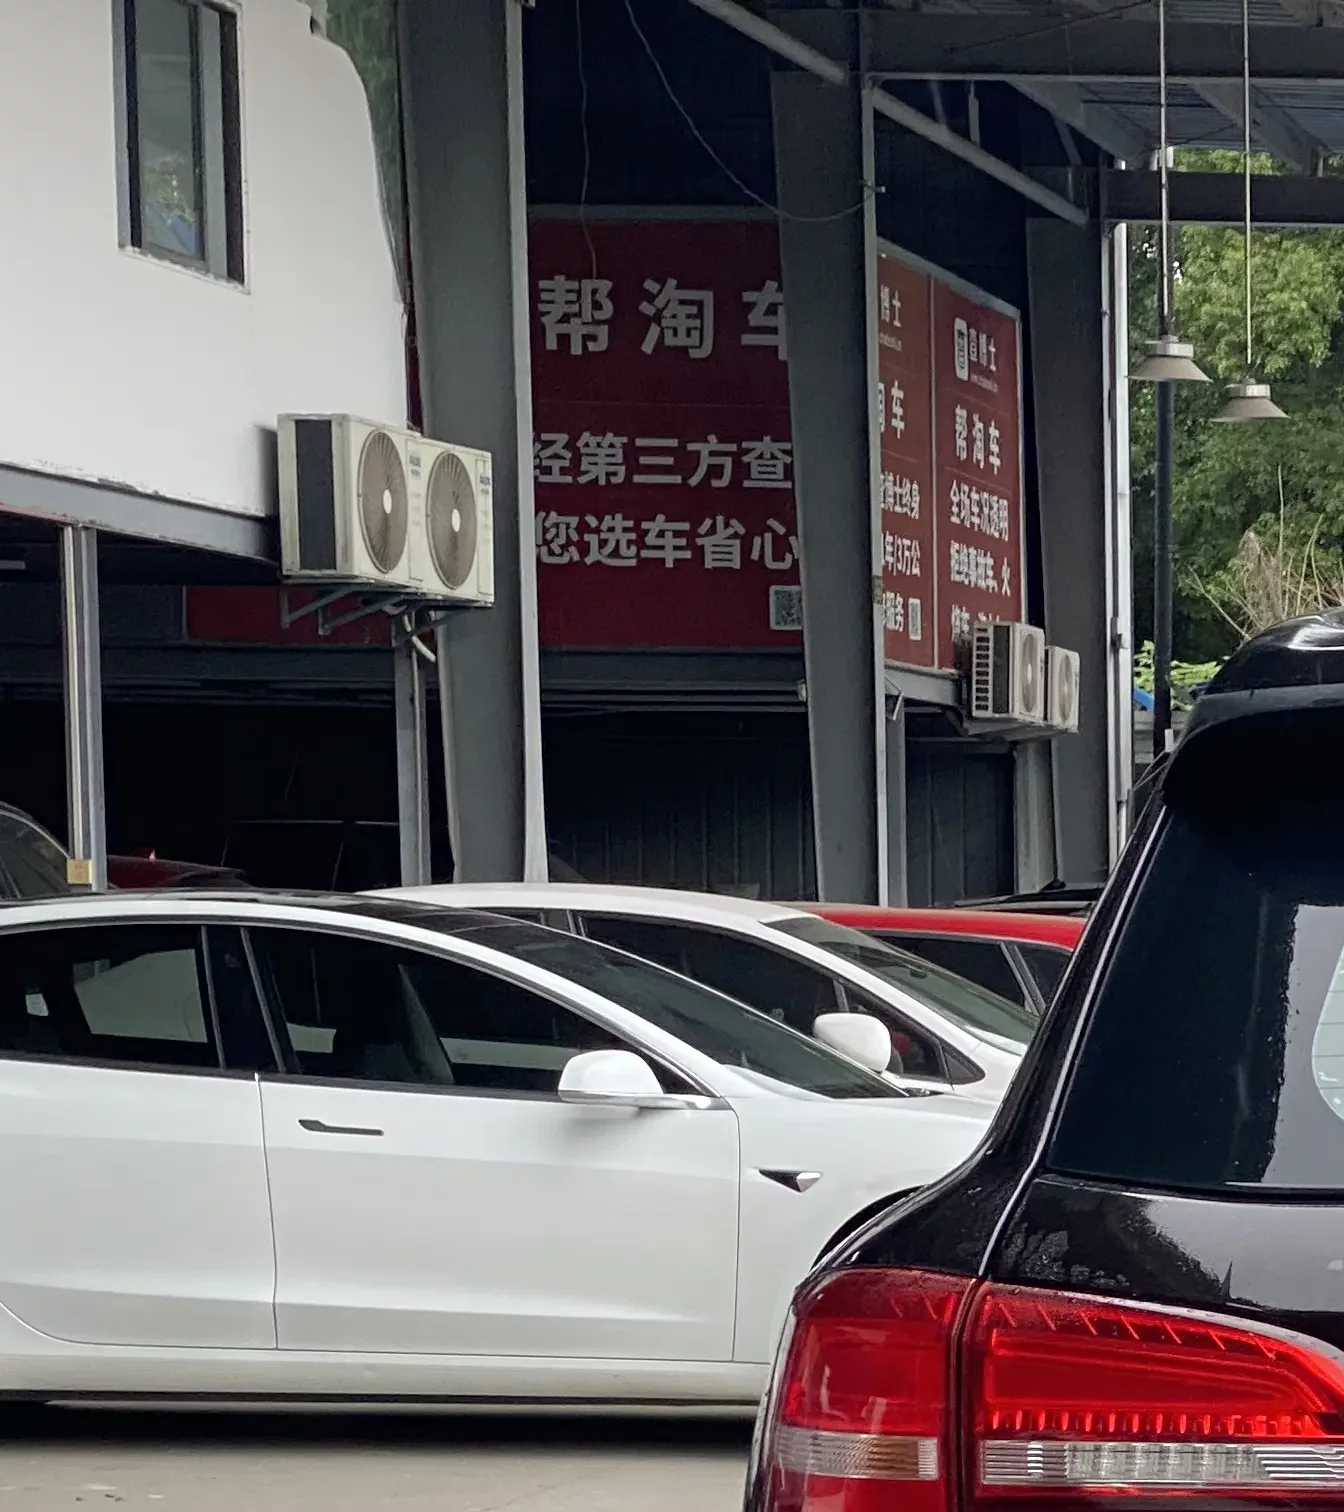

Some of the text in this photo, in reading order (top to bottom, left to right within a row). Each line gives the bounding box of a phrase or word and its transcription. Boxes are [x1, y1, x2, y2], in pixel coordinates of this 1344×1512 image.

[538, 274, 788, 361] 帮淘车
[955, 403, 1001, 476] 帮淘车
[535, 510, 799, 569] 您选车省心
[950, 479, 1009, 542] 全场车况透明
